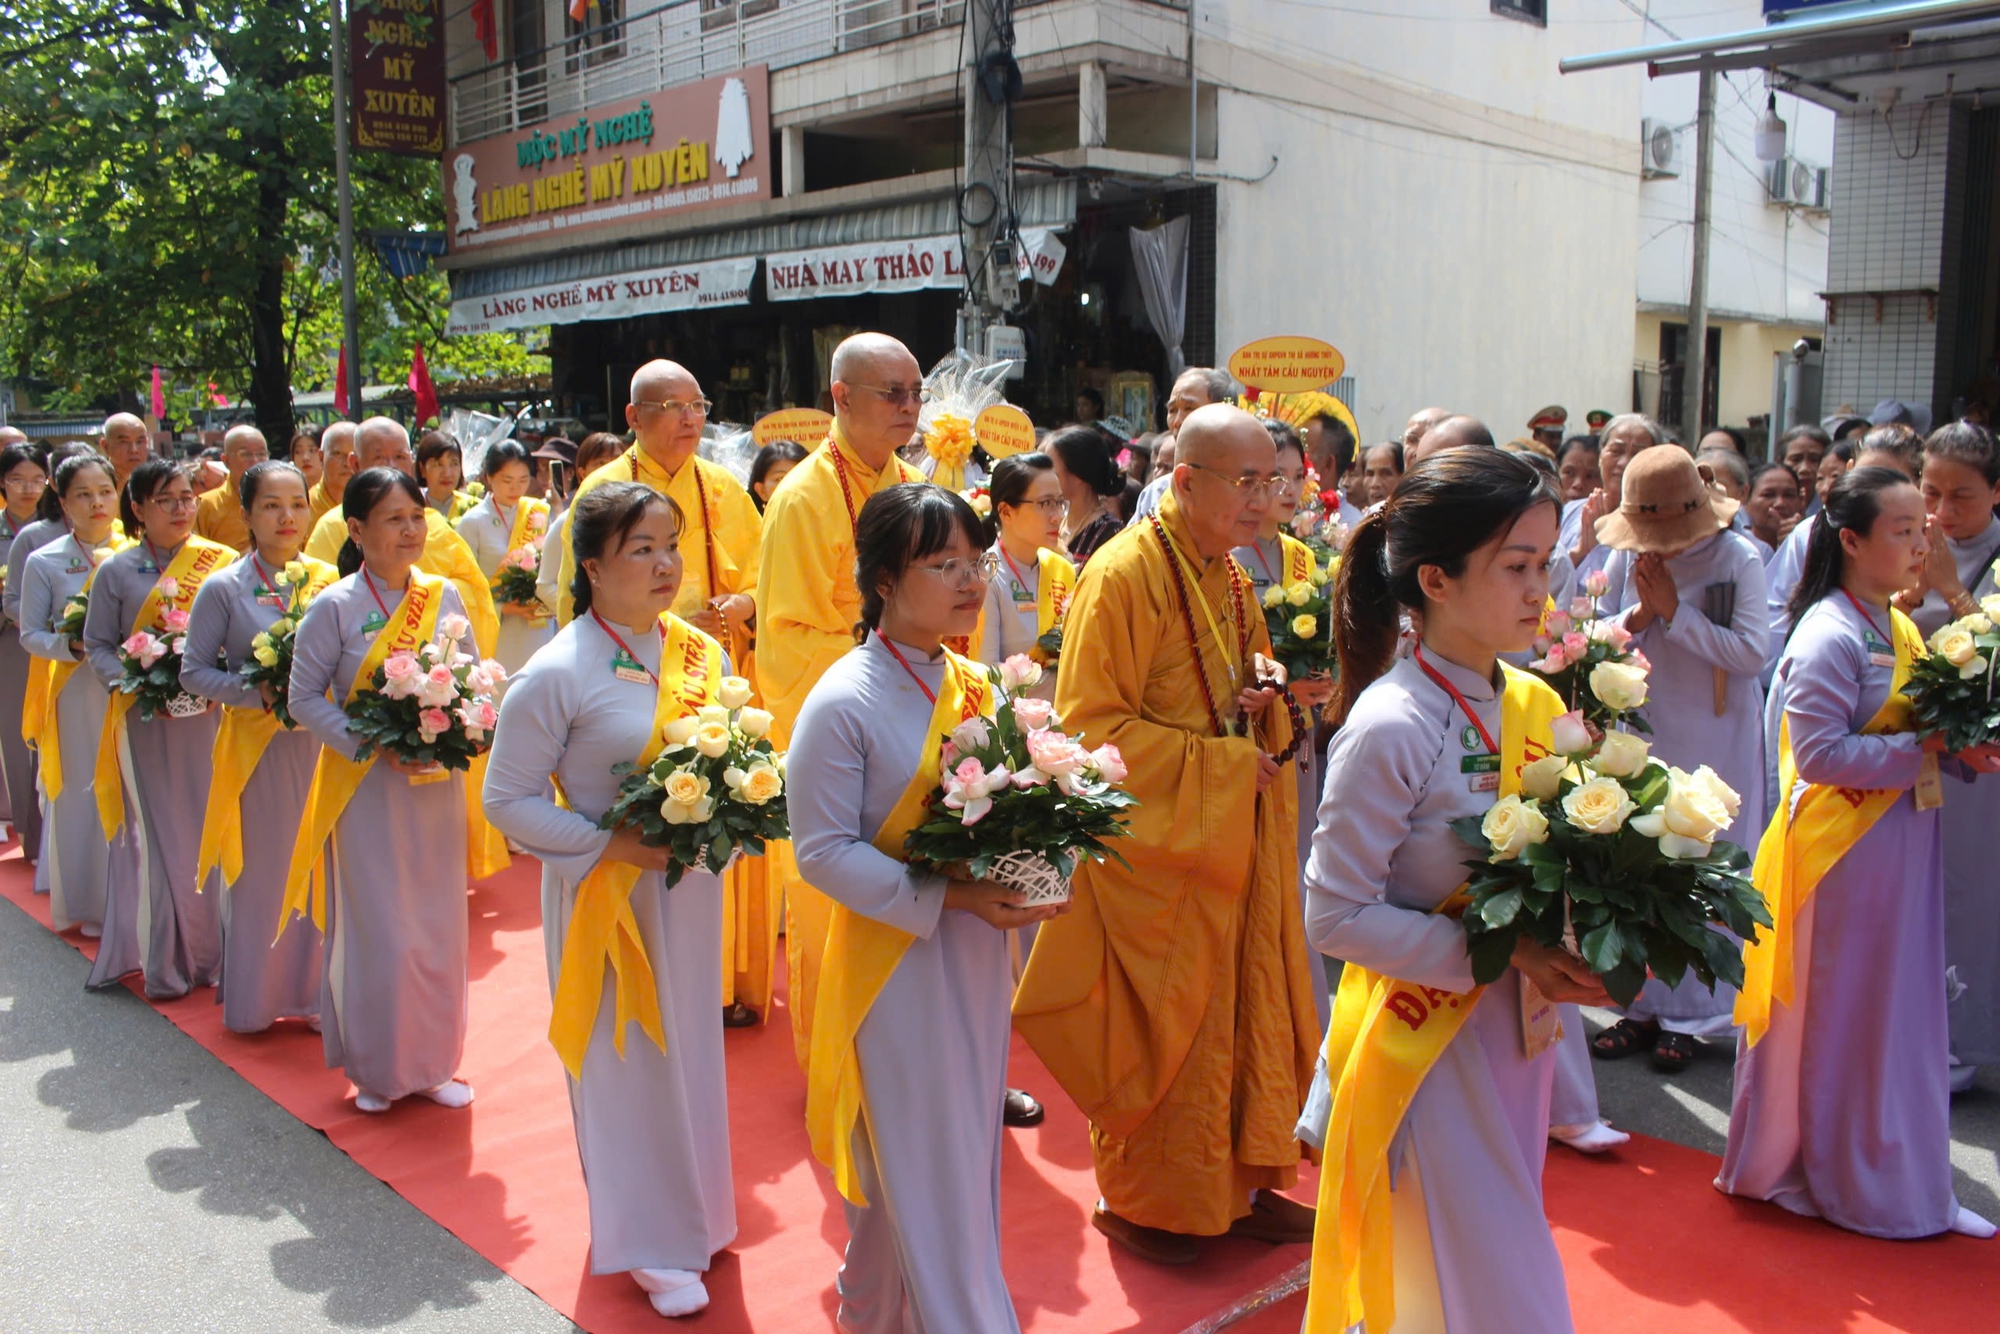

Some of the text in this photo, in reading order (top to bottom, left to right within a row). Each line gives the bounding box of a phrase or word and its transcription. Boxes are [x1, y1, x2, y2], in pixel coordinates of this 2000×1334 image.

[383, 52, 415, 81] MỸ
[364, 88, 435, 117] XUYÊN
[517, 100, 654, 170] MỘC MỸ NGHỆ
[481, 181, 531, 224] LÀNG
[533, 157, 586, 213] NGHỀ
[590, 154, 625, 202] MỸ
[630, 138, 708, 195] XUYÊN
[772, 258, 819, 290] NHÀ
[822, 258, 867, 286] MAY
[874, 243, 934, 281] THẢO
[482, 270, 700, 318] LÀNG NGHỀ MỸ XUYÊN
[1301, 364, 1334, 380] NGUYỆN
